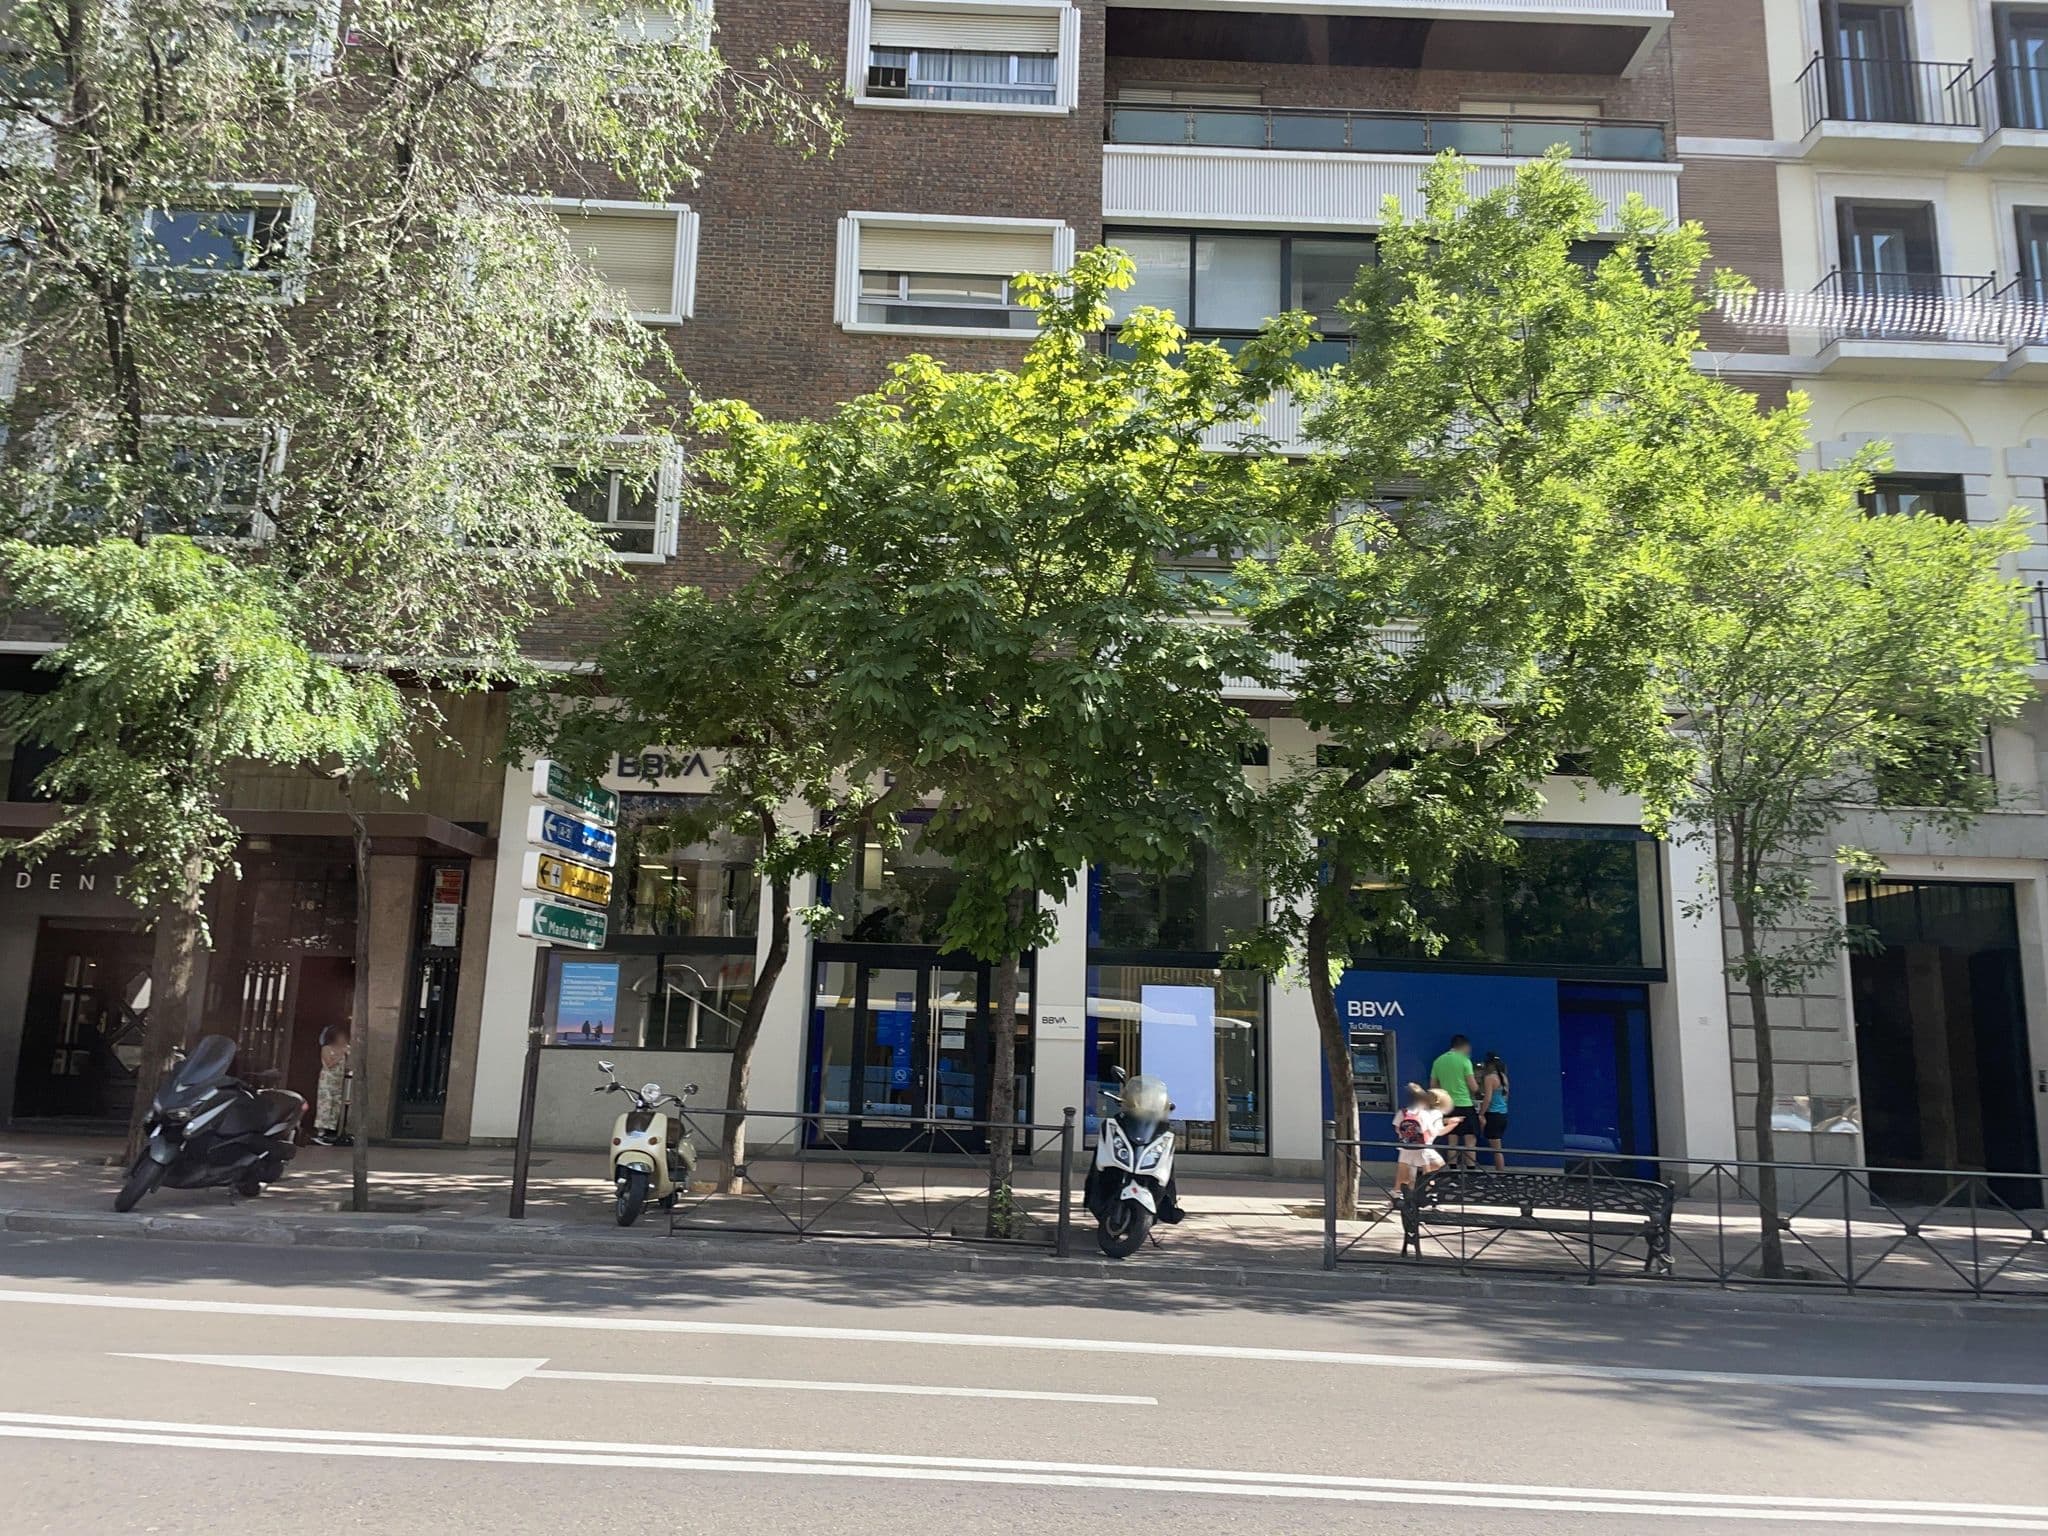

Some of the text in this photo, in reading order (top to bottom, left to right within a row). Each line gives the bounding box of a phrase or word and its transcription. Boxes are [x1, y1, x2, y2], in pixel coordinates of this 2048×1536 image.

[570, 926, 580, 939] de
[1348, 1000, 1405, 1018] BBVA
[1041, 1016, 1068, 1025] BBVA
[1348, 1022, 1383, 1031] Tu Oficina
